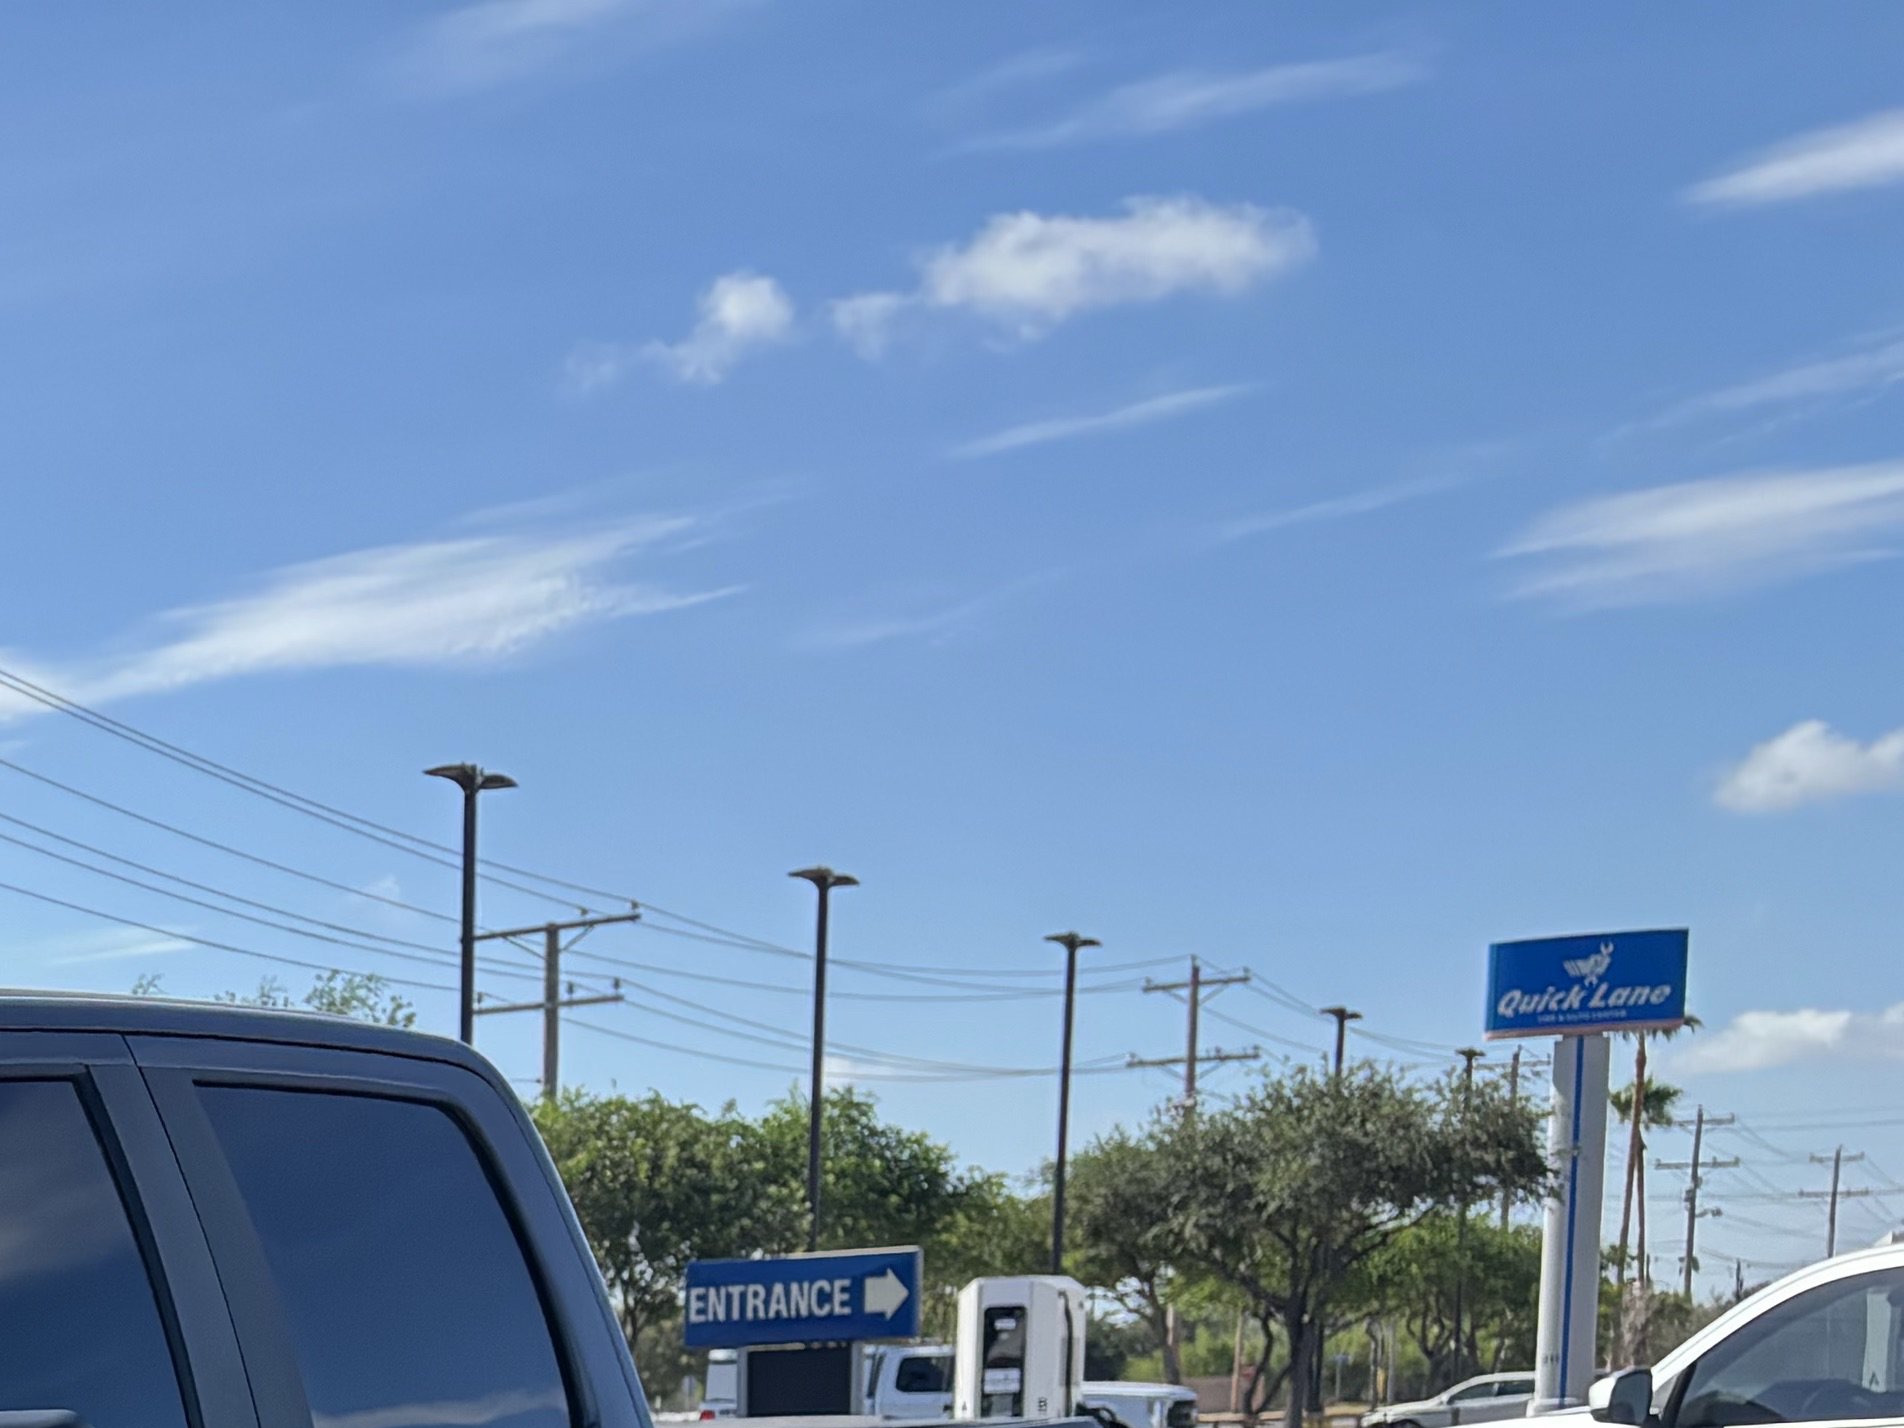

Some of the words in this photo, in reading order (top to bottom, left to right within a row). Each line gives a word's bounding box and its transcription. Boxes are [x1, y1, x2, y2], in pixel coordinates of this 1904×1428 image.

[1497, 984, 1587, 1018] Quick
[1589, 982, 1673, 1009] Lane
[689, 1278, 852, 1324] ENTRANCE
